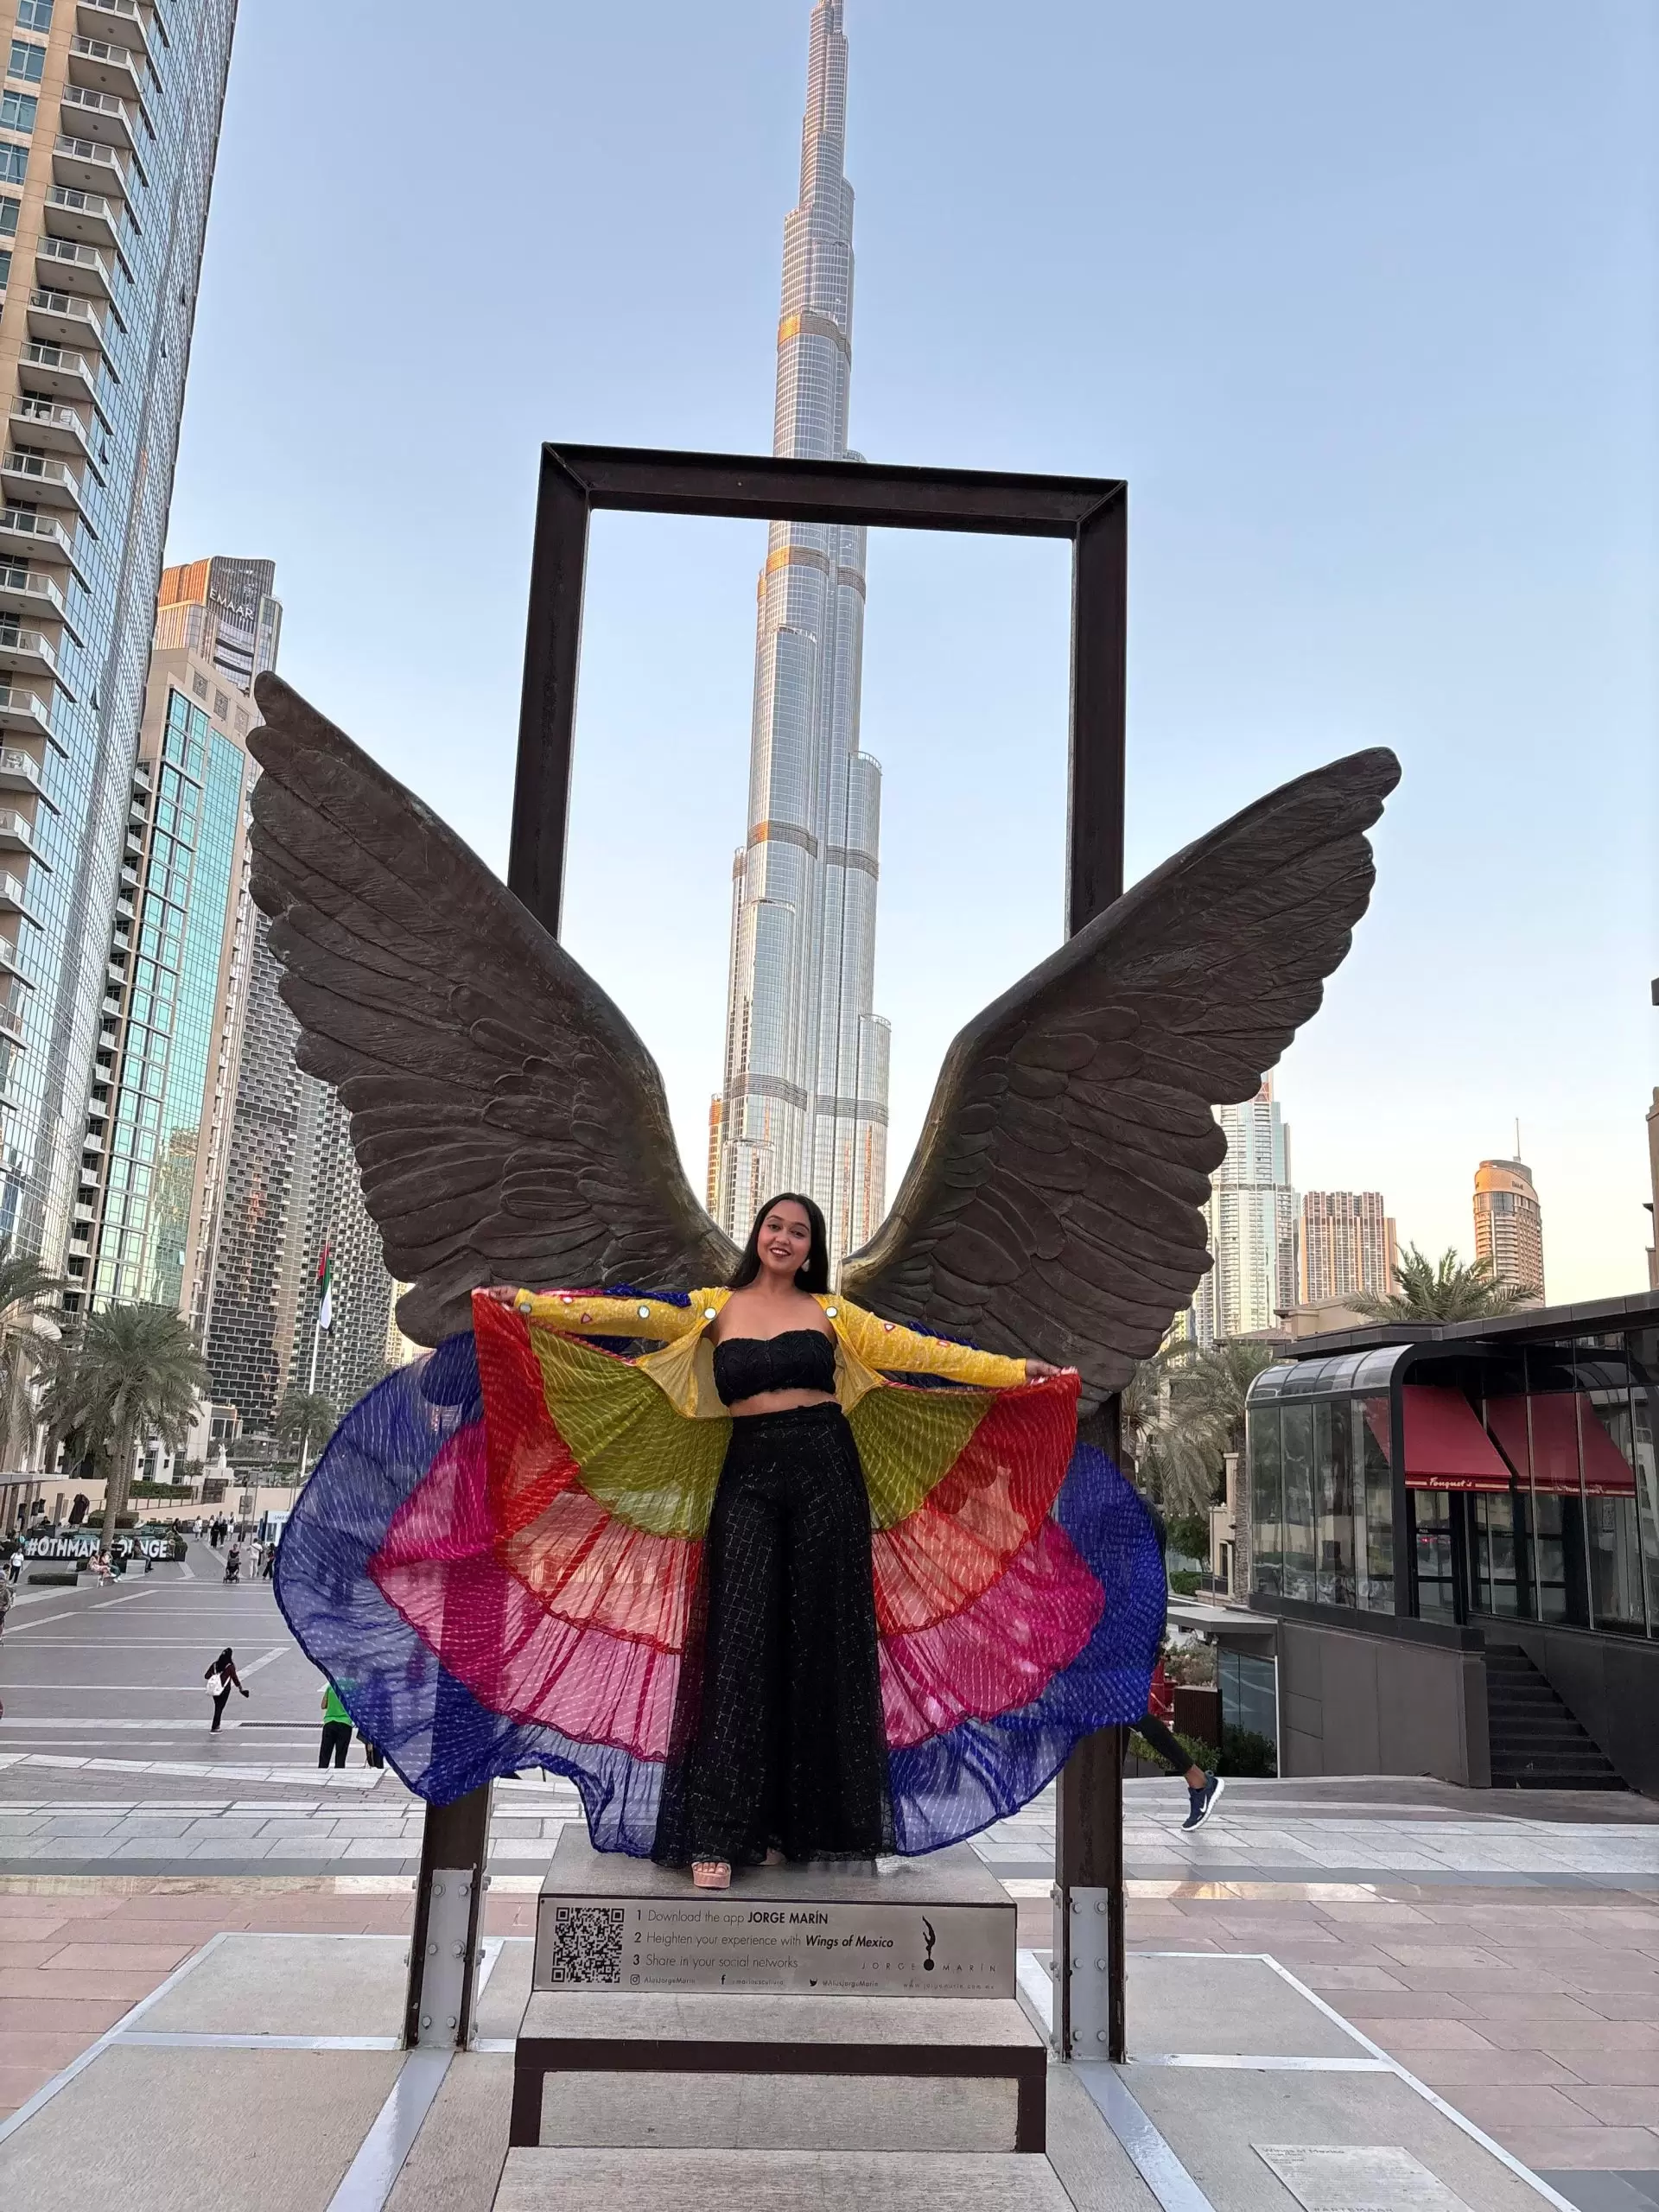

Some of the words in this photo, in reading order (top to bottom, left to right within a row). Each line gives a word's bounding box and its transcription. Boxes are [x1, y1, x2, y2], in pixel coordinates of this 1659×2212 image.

[209, 588, 254, 620] EMAAR
[1428, 1476, 1472, 1490] Fouquet's
[637, 1910, 641, 1921] 1
[648, 1909, 701, 1923] Download
[705, 1910, 720, 1923] the
[723, 1913, 745, 1927] app
[747, 1911, 785, 1923] JORGE
[789, 1910, 828, 1924] MARÍN
[634, 1931, 642, 1943] 2
[646, 1931, 692, 1947] Heighten
[696, 1936, 718, 1948] your
[721, 1936, 778, 1948] experience
[780, 1934, 801, 1945] with
[805, 1935, 838, 1949] Wings
[842, 1934, 855, 1946] of
[855, 1936, 894, 1948] Mexico
[632, 1954, 640, 1966] 3
[645, 1954, 676, 1967] Share
[680, 1955, 689, 1967] in
[693, 1958, 715, 1970] your
[719, 1954, 749, 1967] social
[753, 1955, 798, 1968] networks
[861, 1962, 917, 1971] JORGE
